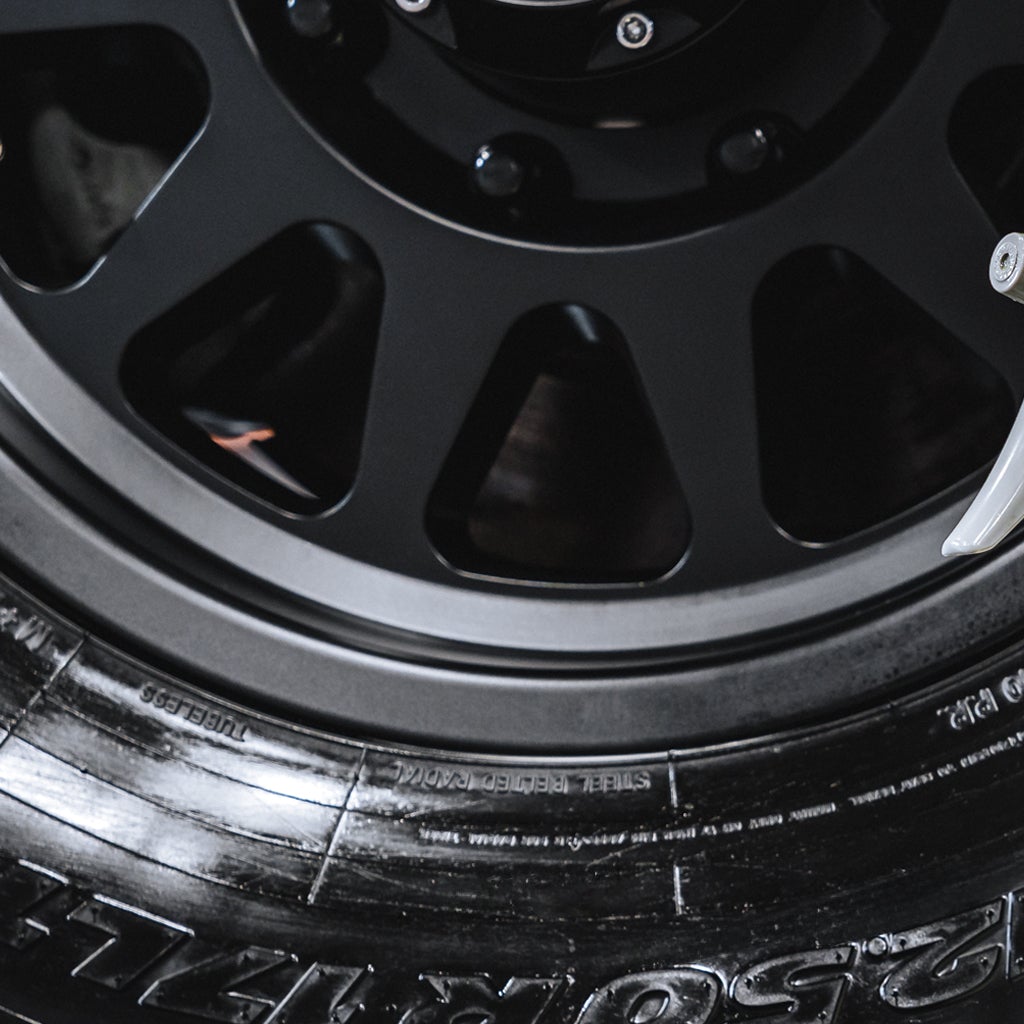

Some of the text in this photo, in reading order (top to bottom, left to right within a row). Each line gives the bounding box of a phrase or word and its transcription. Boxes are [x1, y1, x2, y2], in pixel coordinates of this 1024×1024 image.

[140, 683, 249, 742] TUBELESS
[390, 760, 651, 794] STEEL BELTED RADIAL
